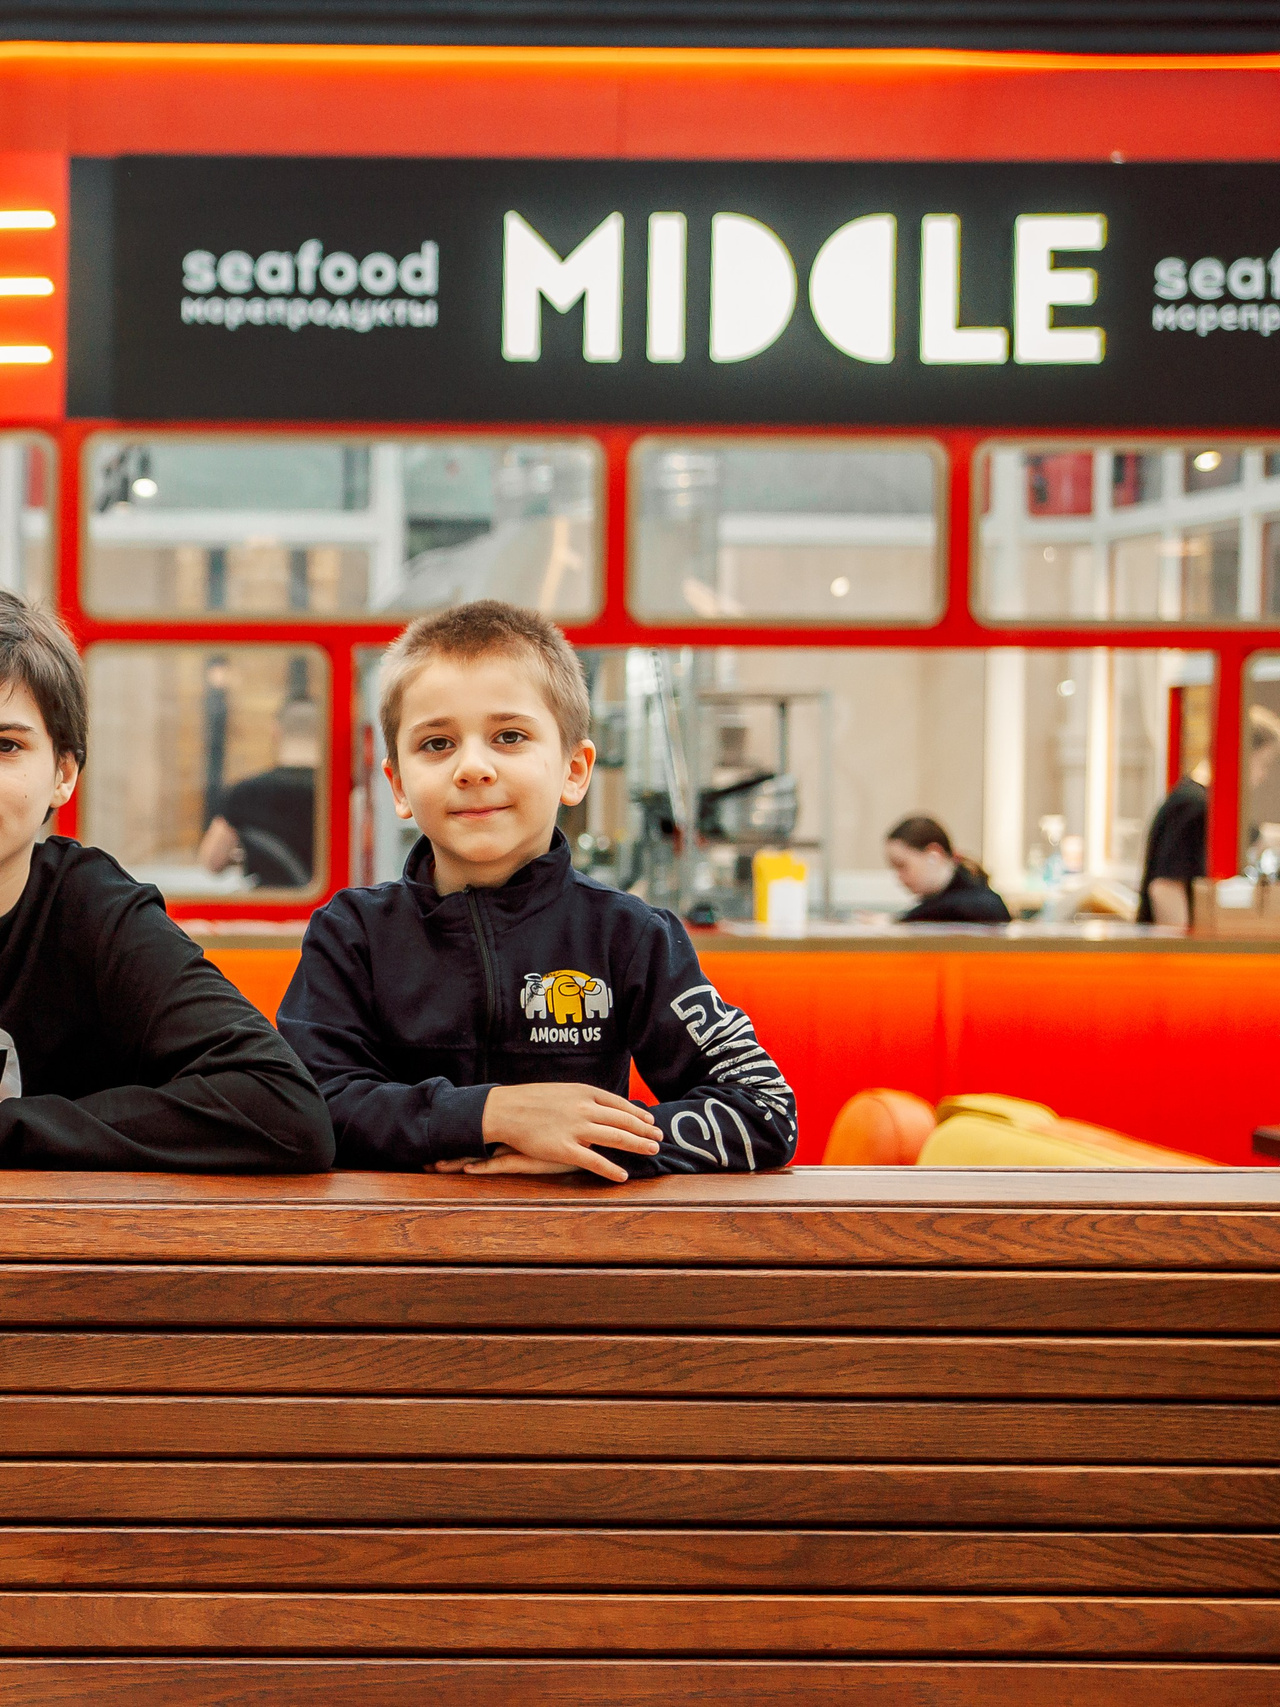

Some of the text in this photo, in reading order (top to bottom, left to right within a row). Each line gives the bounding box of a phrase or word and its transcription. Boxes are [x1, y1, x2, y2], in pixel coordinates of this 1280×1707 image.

[182, 239, 439, 296] seafood
[501, 210, 1107, 365] MIDDLE
[530, 1026, 602, 1045] AMONG US
